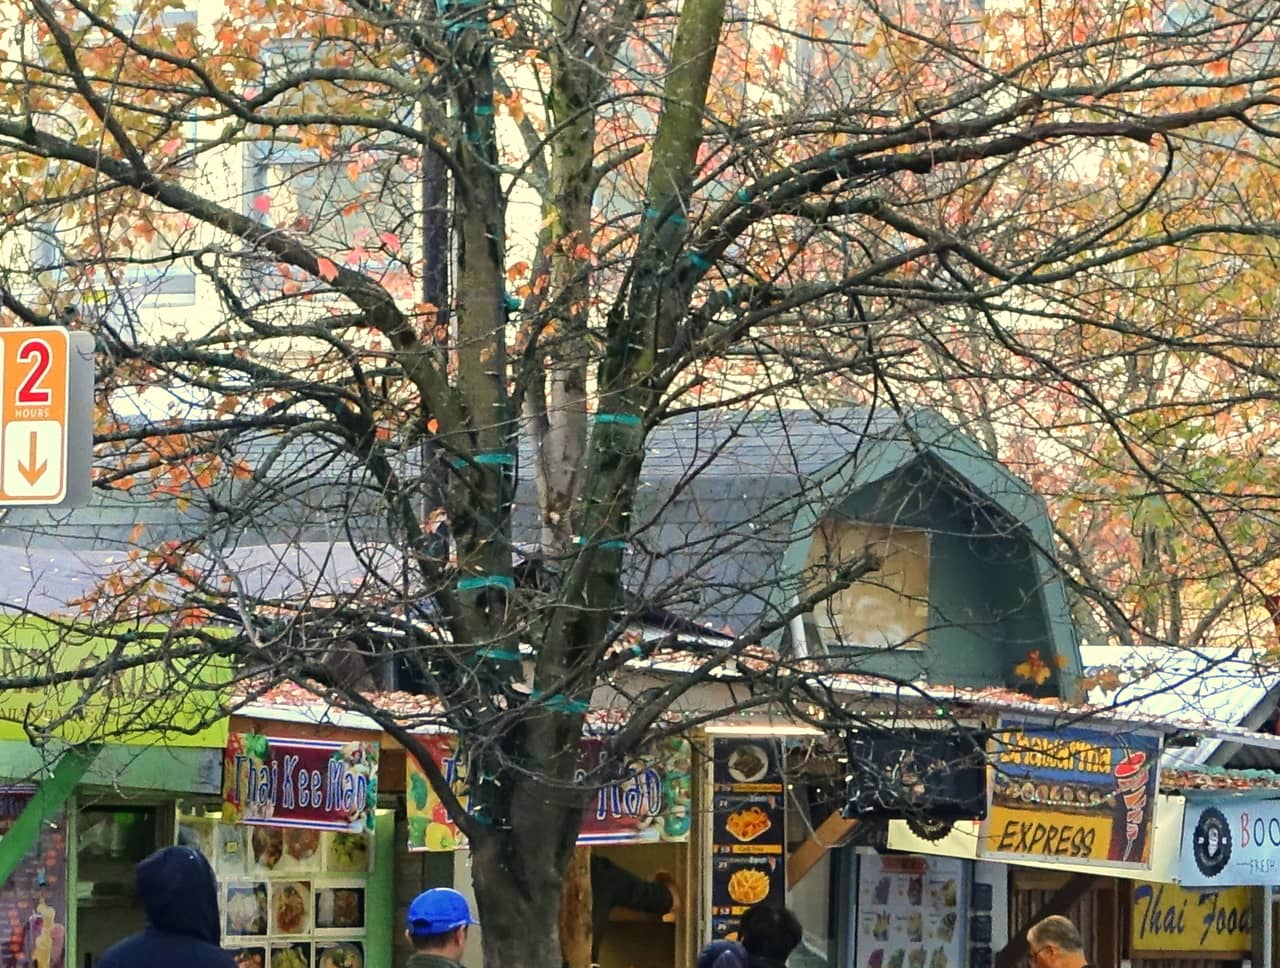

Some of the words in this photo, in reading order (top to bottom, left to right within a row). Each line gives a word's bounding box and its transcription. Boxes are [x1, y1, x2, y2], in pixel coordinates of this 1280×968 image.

[16, 339, 52, 405] 2
[15, 408, 50, 418] HOURS
[999, 732, 1112, 775] Shawarma
[233, 754, 279, 807] Thai
[282, 754, 323, 810] Kee
[325, 757, 368, 812] Man
[997, 819, 1096, 858] EXPRESS
[1134, 884, 1188, 940] Thai
